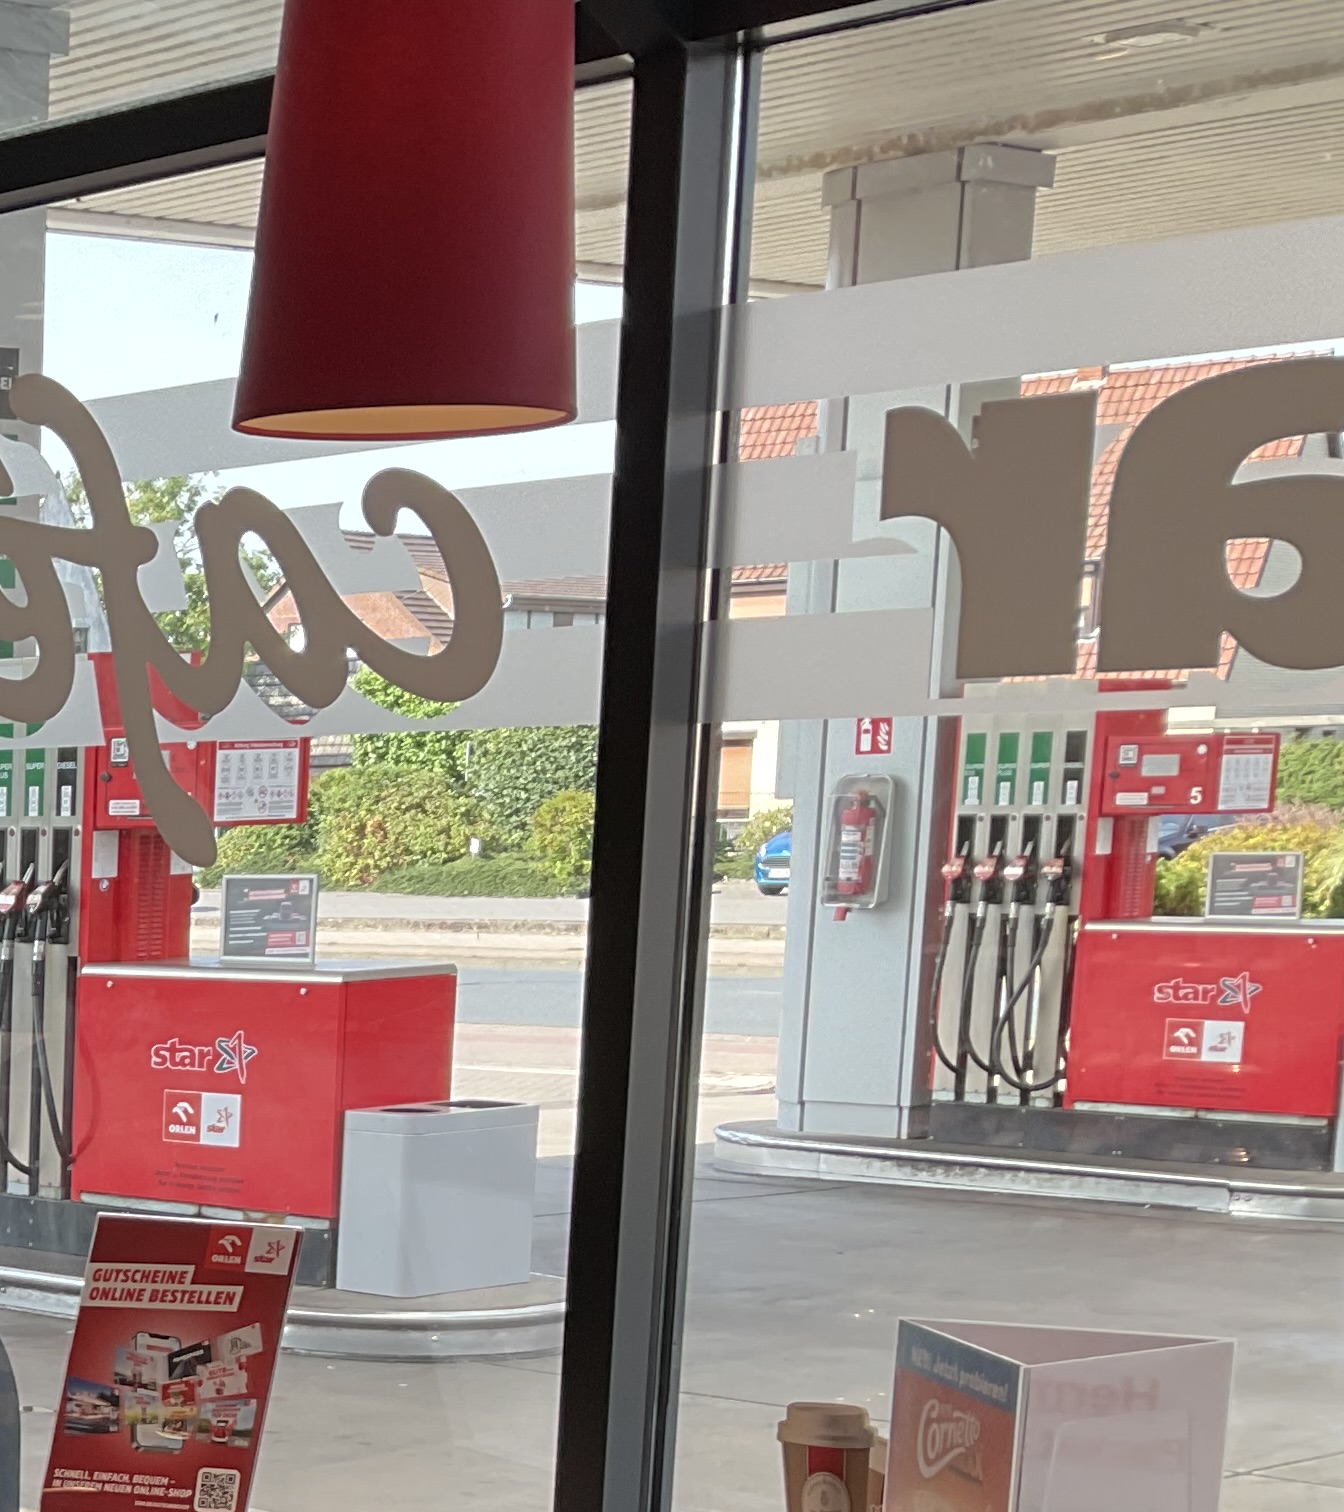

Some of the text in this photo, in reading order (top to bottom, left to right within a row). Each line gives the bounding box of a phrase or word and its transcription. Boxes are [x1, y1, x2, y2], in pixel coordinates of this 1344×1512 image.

[1190, 786, 1203, 805] 5
[1154, 977, 1217, 1004] star
[151, 1037, 213, 1071] star
[168, 1124, 197, 1135] ORLEN
[211, 1253, 242, 1265] ORLEN
[92, 1267, 189, 1285] GUTSCHEINE
[88, 1286, 237, 1306] ONLINE BESTELLEN
[916, 1398, 982, 1480] Cornetto
[132, 1474, 169, 1486] BEQUEM
[103, 1483, 133, 1495] NEUEN
[133, 1485, 193, 1499] ONLINE-SHOP
